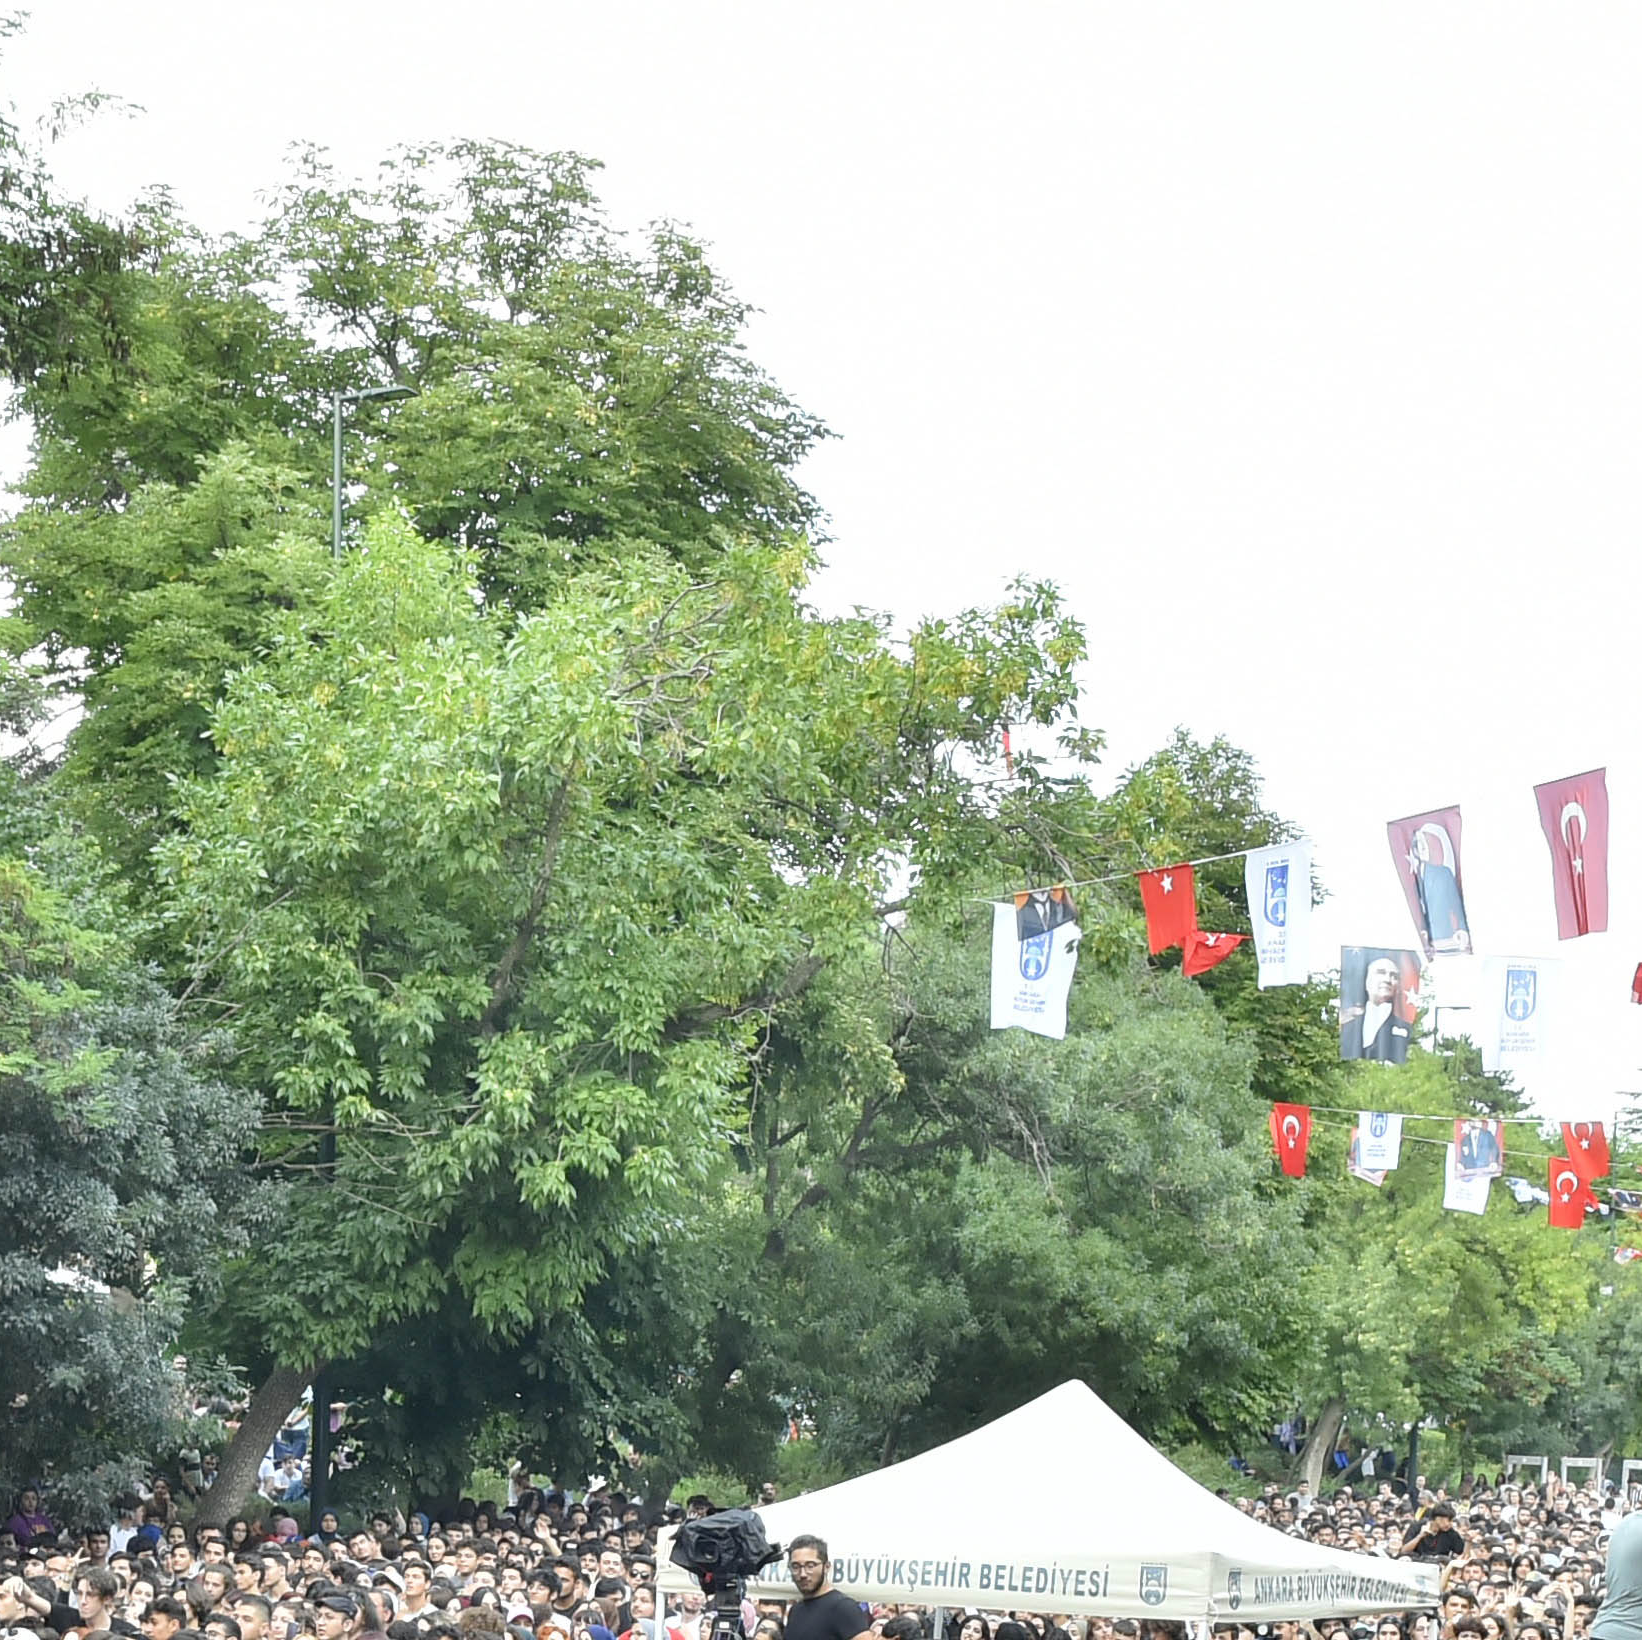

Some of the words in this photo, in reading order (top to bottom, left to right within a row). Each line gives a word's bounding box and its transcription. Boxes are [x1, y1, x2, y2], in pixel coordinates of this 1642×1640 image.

[833, 1552, 971, 1593] BÜYÜKŞEHİR
[979, 1556, 1110, 1598] BELEDİYESİ
[1254, 1576, 1296, 1604] ANKARA
[1297, 1569, 1357, 1607] BÜYÜKŞEHİR
